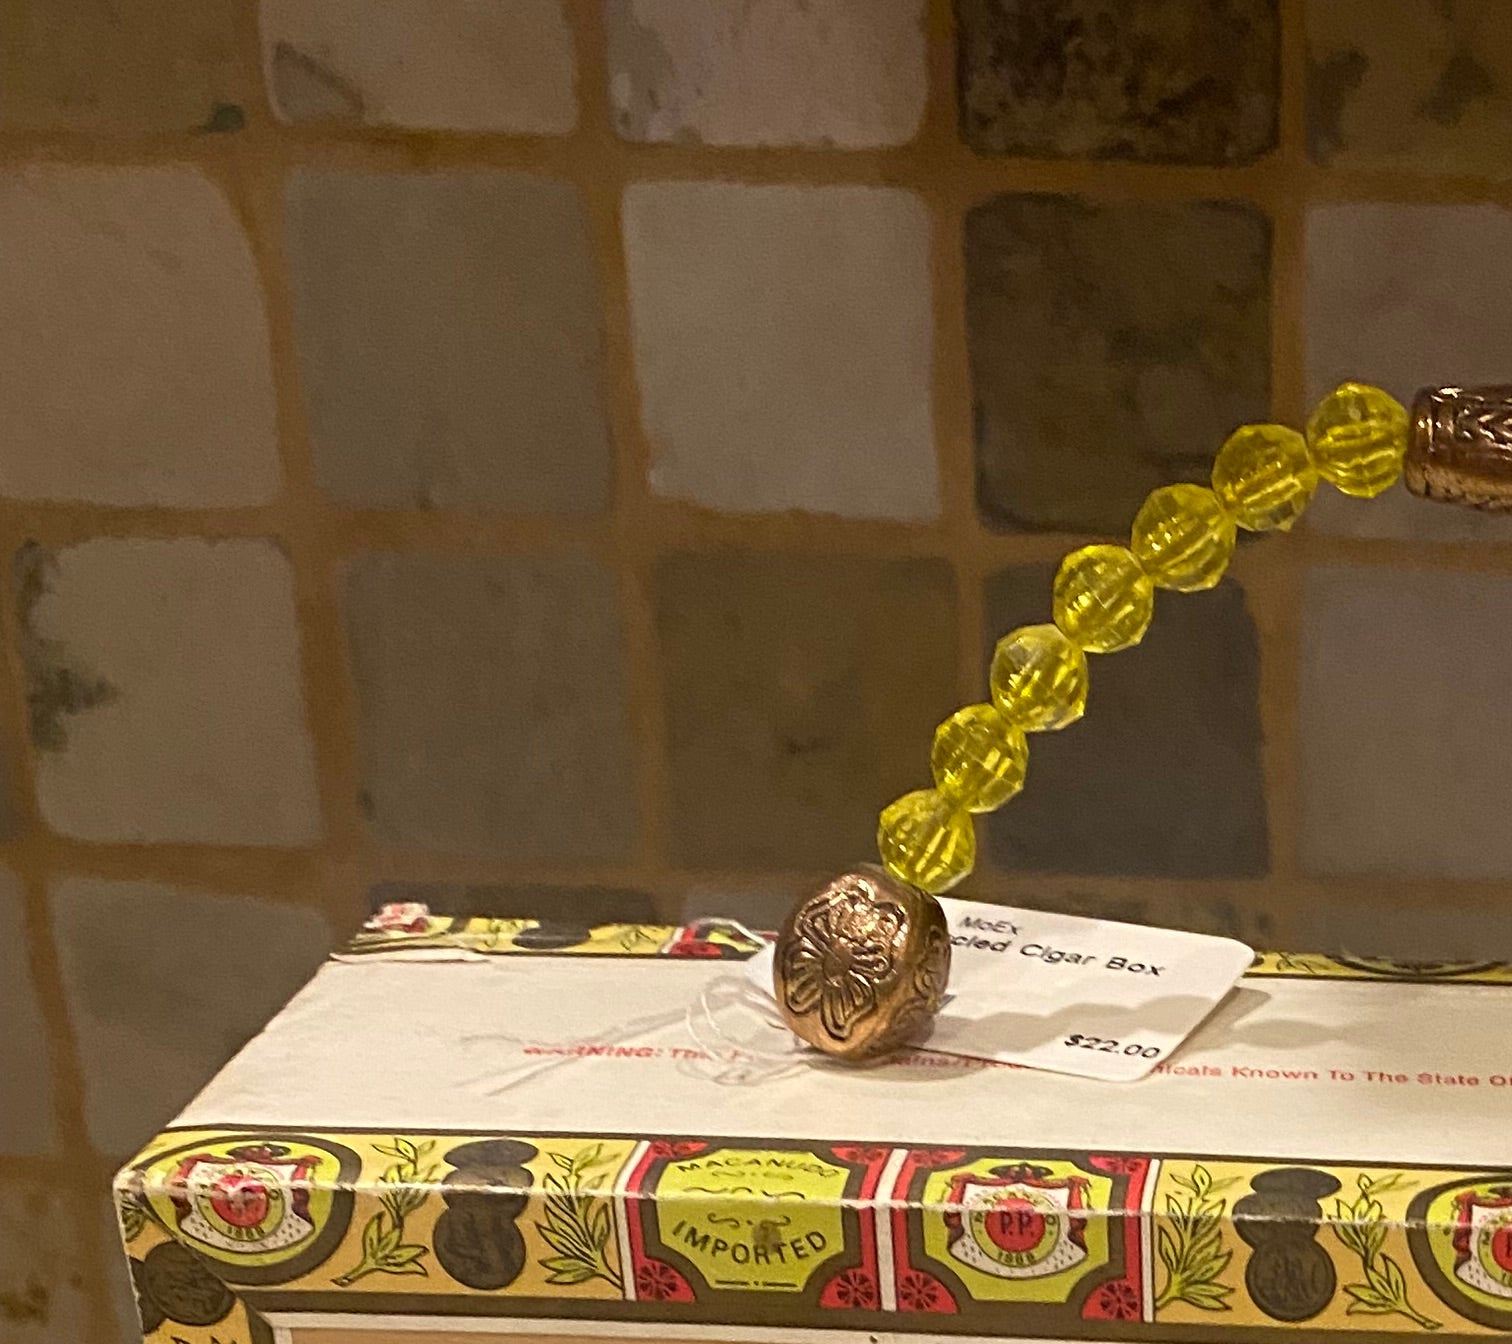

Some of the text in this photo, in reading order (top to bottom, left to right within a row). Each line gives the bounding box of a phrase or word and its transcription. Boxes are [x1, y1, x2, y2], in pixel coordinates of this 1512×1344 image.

[950, 935, 1167, 977] cled Cigar Box
[1064, 1033, 1161, 1059] $22.00
[1150, 1064, 1222, 1077] icals
[1231, 1066, 1319, 1080] Known
[1329, 1070, 1355, 1082] To
[1366, 1071, 1409, 1084] The
[1417, 1073, 1480, 1086] State
[672, 1219, 827, 1266] IMPORTED
